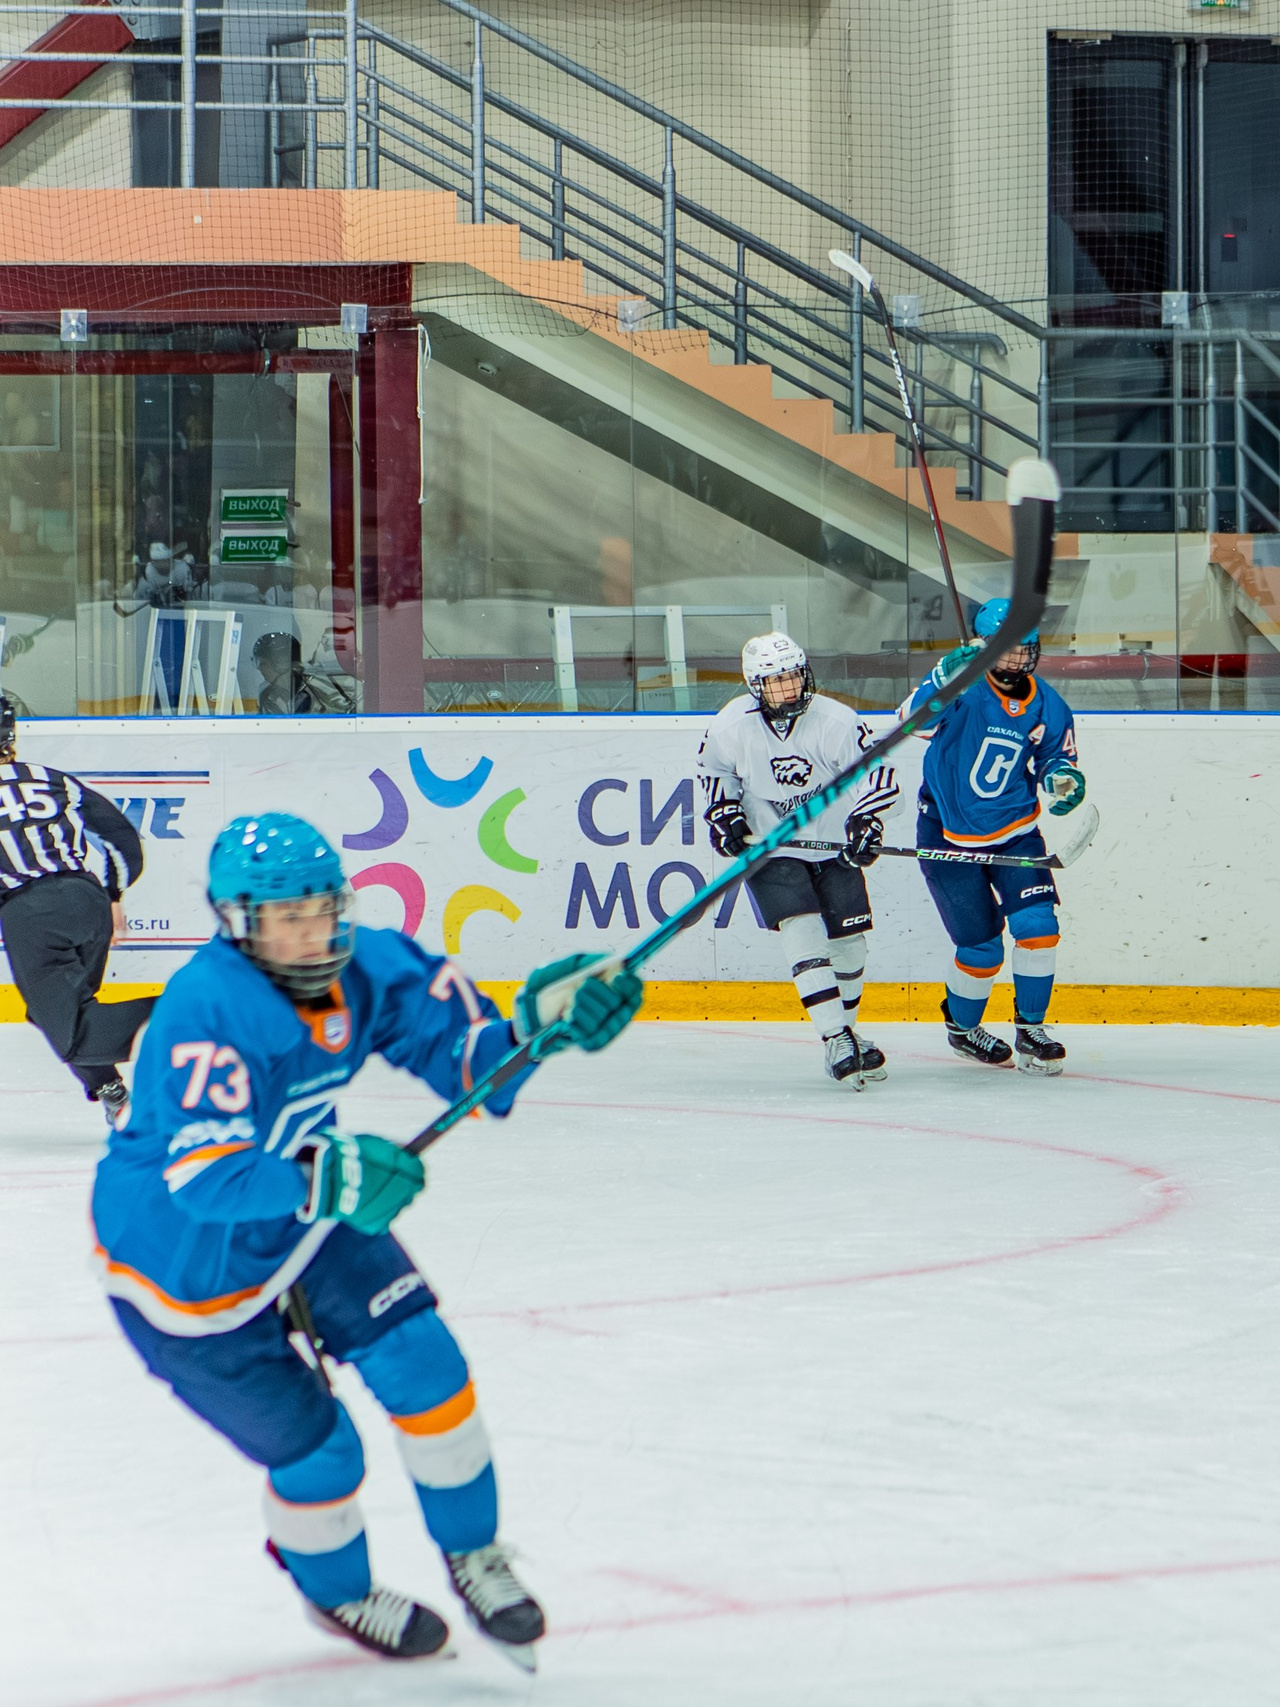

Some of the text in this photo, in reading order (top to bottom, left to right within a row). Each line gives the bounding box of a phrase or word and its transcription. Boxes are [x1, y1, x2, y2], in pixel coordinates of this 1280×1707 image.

[229, 500, 279, 511] ВЫХОД
[229, 540, 279, 551] ВЫХОД
[0, 783, 58, 822] 45
[1020, 885, 1054, 898] CCM
[171, 1040, 251, 1114] 73
